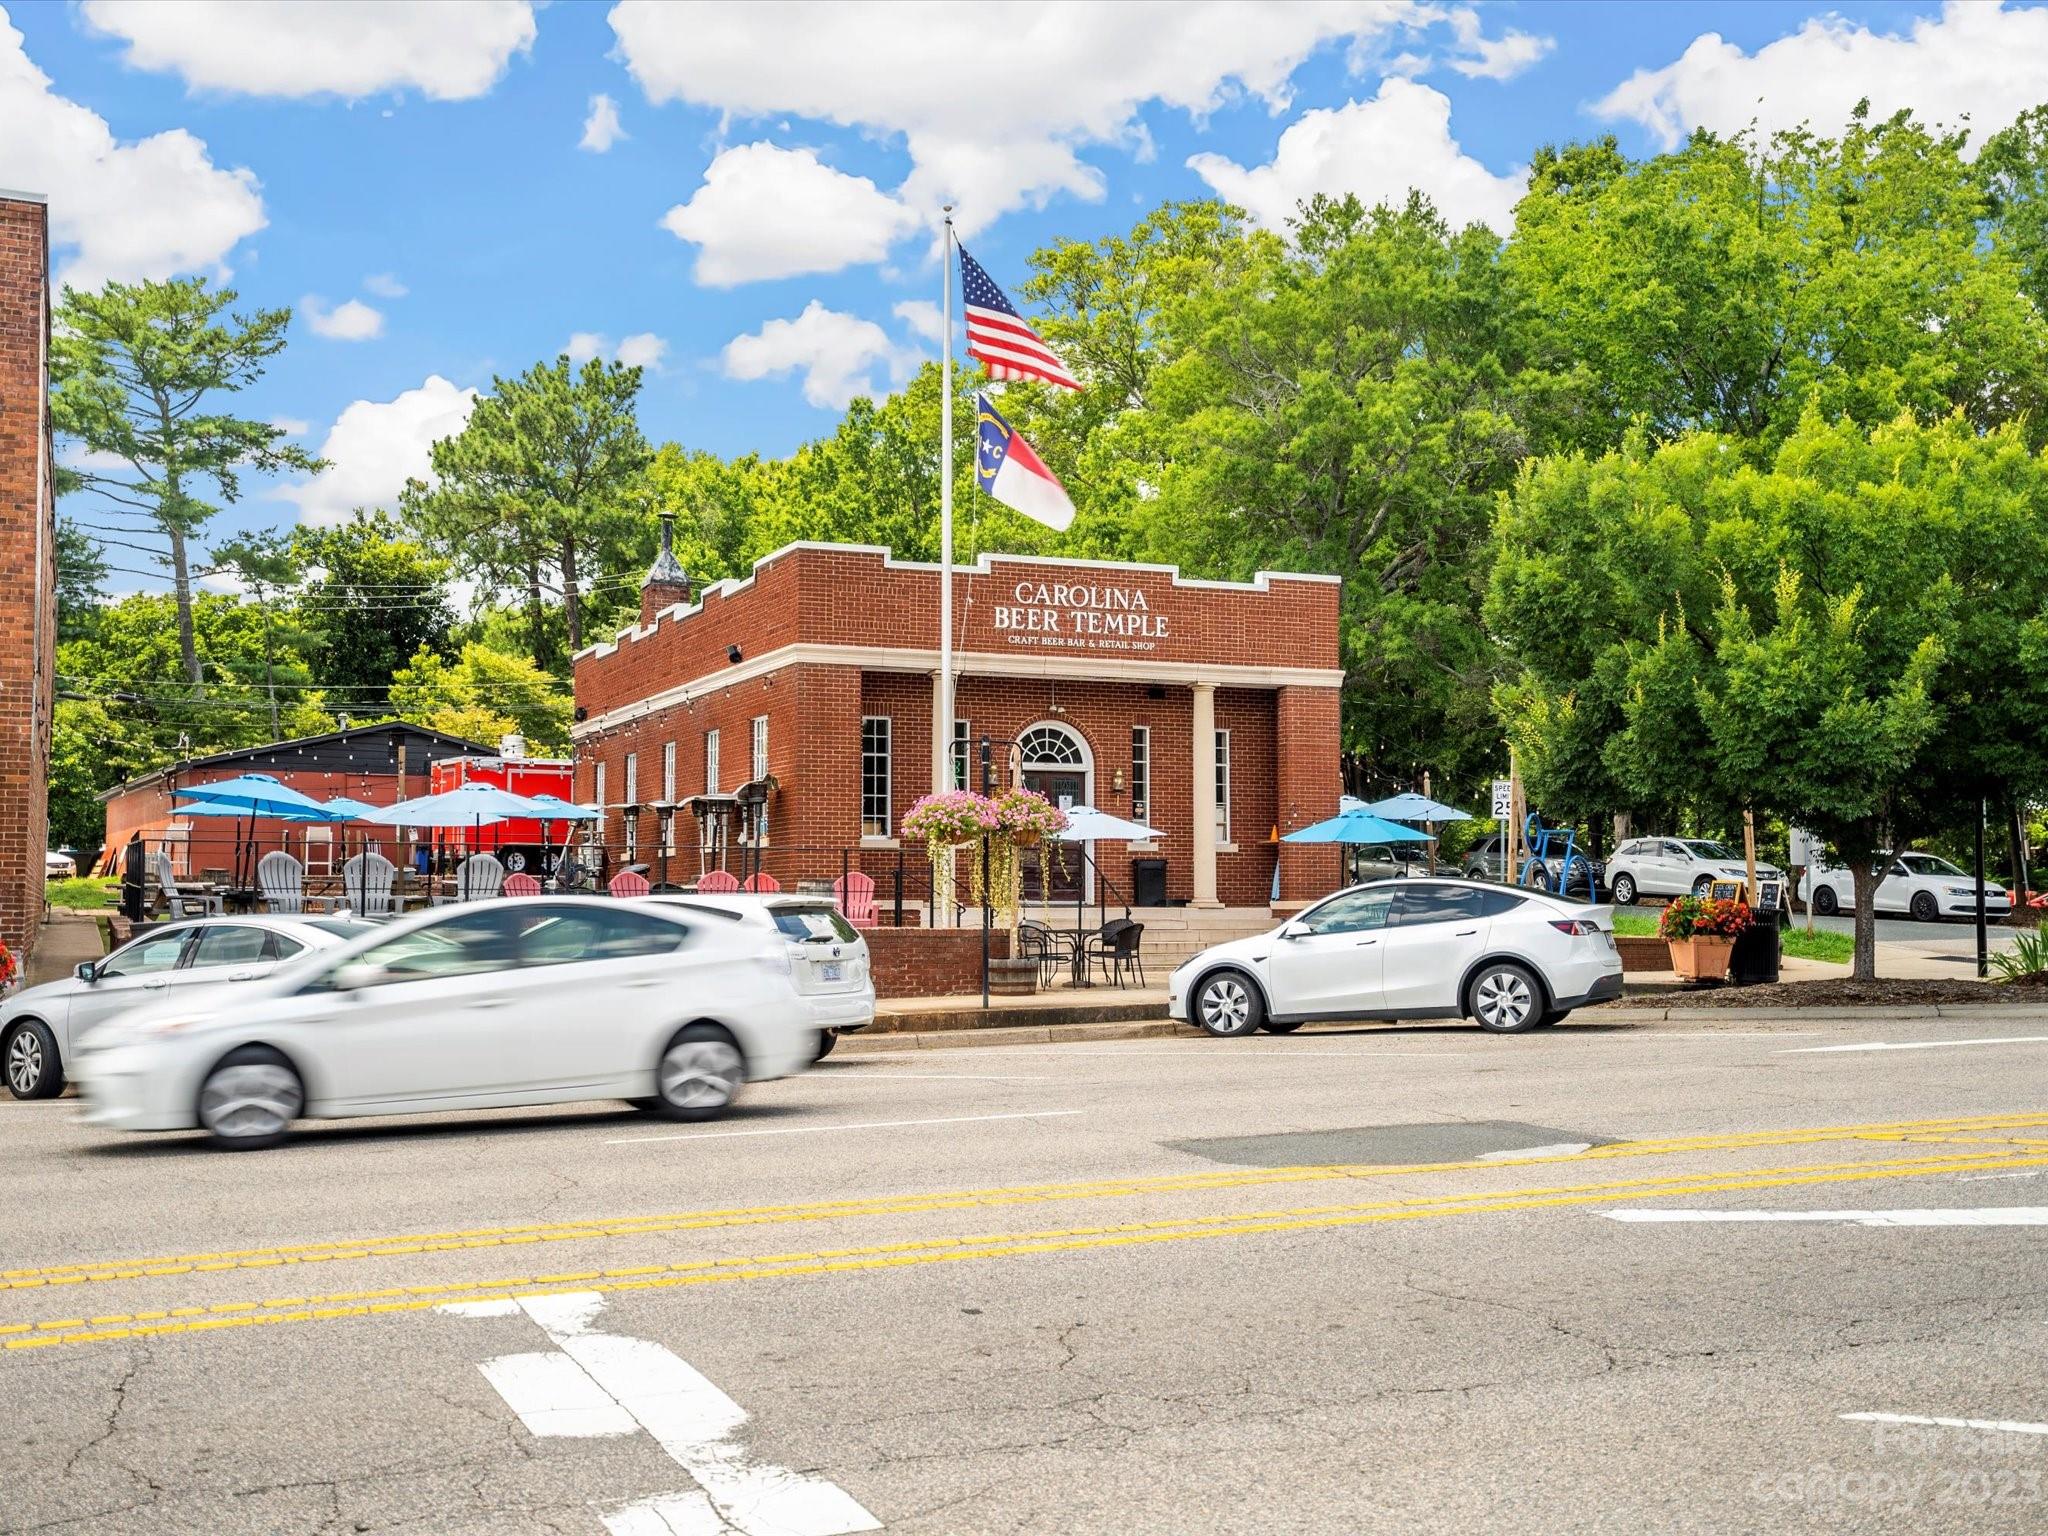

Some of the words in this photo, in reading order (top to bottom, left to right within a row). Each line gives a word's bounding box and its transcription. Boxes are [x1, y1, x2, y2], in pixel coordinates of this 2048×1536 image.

[1015, 582, 1149, 611] CAROLINA
[994, 607, 1060, 632] BEER
[1070, 611, 1170, 638] TEMPLE
[1008, 635, 1039, 646] CRAFT
[1041, 637, 1065, 647] BEER
[1067, 638, 1086, 648] BAR
[1089, 640, 1096, 648] &
[1099, 640, 1130, 650] RETAIL
[1132, 641, 1156, 651] SHOP
